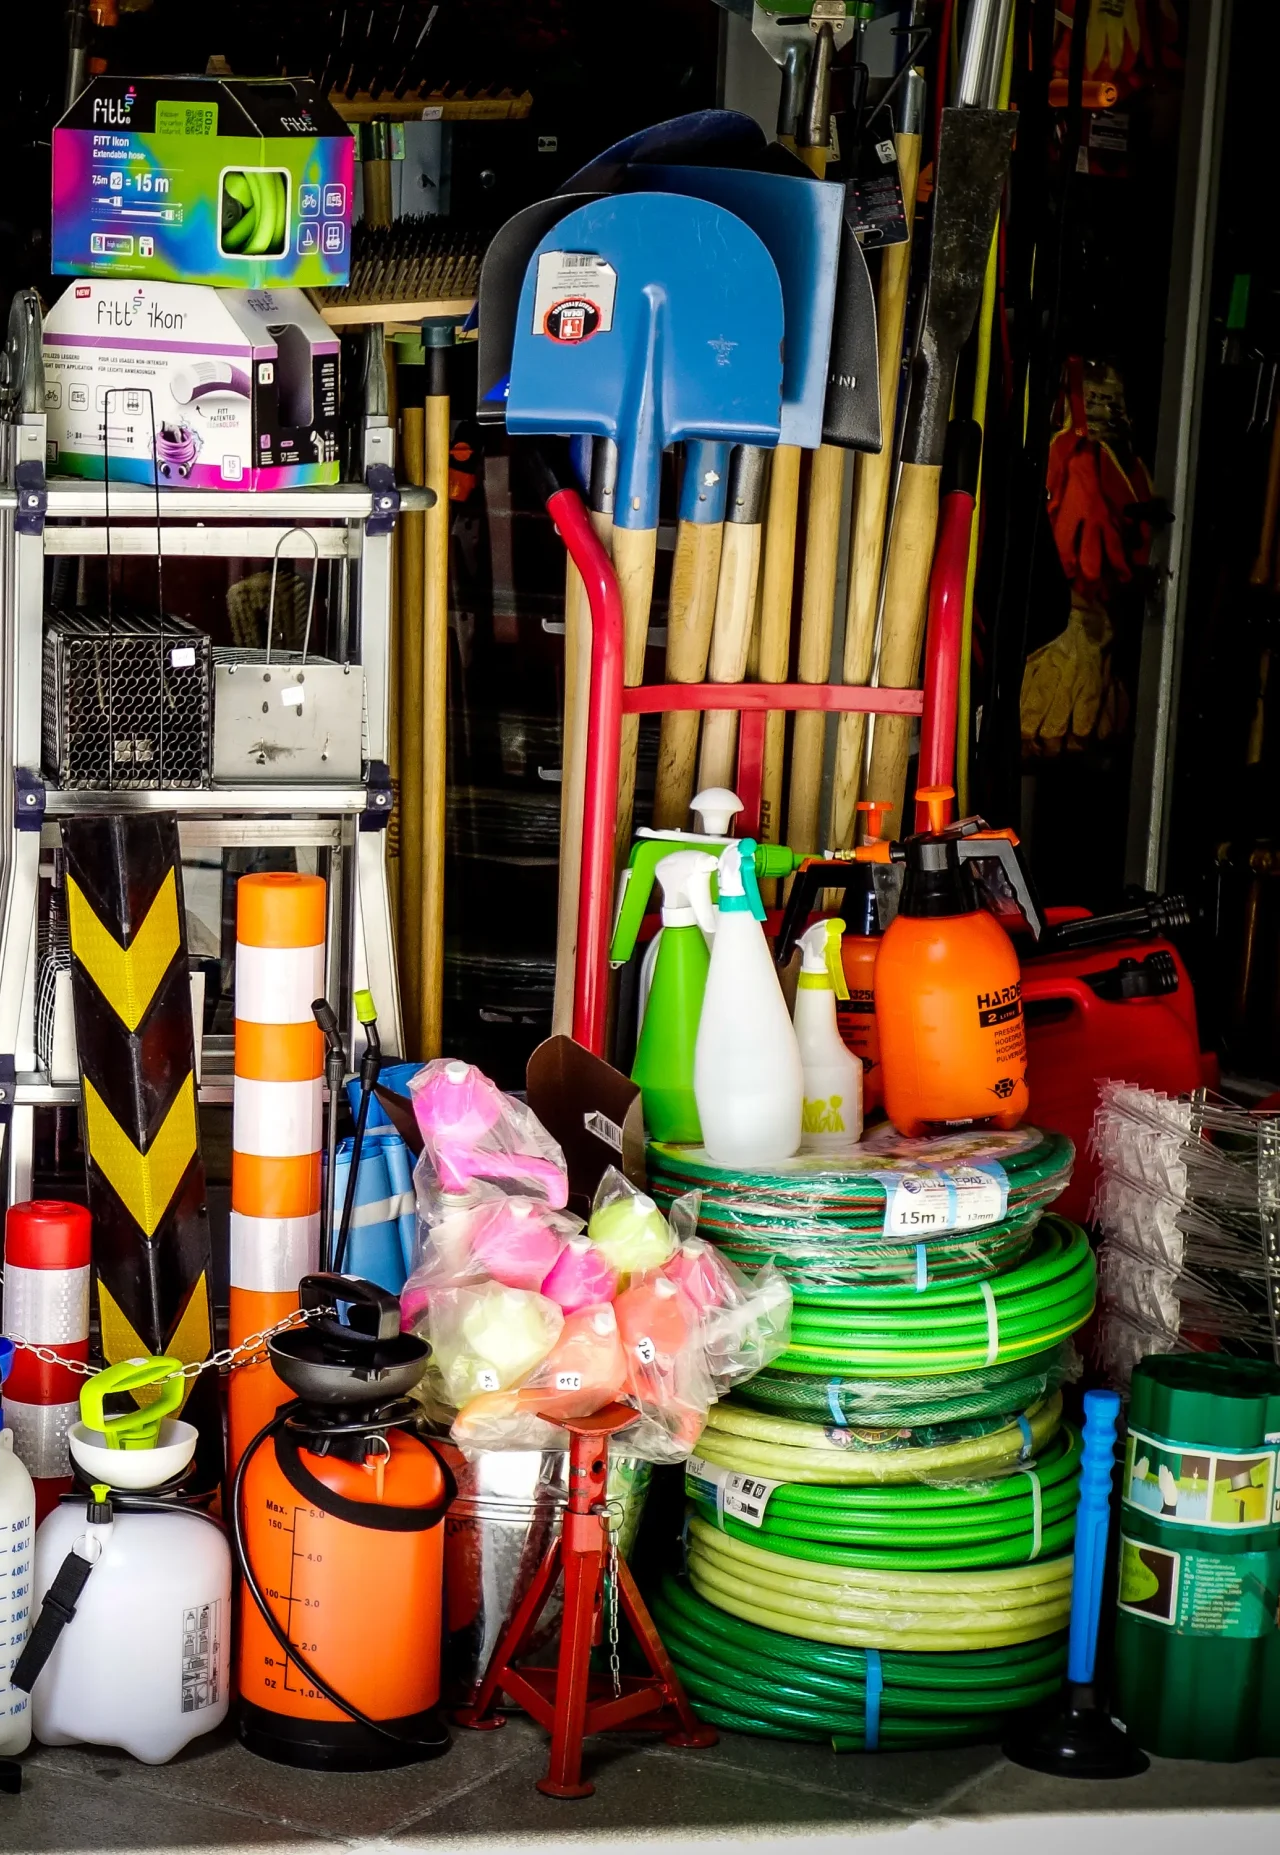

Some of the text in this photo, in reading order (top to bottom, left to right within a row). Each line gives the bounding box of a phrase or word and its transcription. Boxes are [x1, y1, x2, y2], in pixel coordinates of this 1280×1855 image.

[93, 135, 129, 147] FITT Ikon
[93, 149, 127, 159] Extendable
[135, 173, 152, 192] 15
[76, 288, 90, 298] NEW
[97, 299, 183, 330] fitt ikon
[210, 414, 236, 422] PATENTED
[217, 408, 228, 416] FITT
[977, 979, 1022, 1009] HARDE
[988, 1013, 998, 1023] 2
[900, 1211, 994, 1225] 15m 13mm
[266, 1499, 288, 1515] Max.
[310, 1510, 325, 1519] 5.0
[11, 1520, 24, 1532] 5.00
[268, 1518, 282, 1530] 150
[11, 1541, 24, 1553] 4.50
[307, 1554, 323, 1563] 4.0
[11, 1565, 24, 1577] 4.00
[11, 1588, 24, 1600] 3.50
[265, 1588, 279, 1599] 100
[305, 1598, 320, 1608] 3.0
[11, 1611, 24, 1623] 3.00
[10, 1634, 23, 1646] 2.50
[301, 1642, 317, 1652] 2.0
[264, 1656, 274, 1667] 50
[264, 1678, 277, 1689] OZ
[10, 1704, 23, 1716] 1.00
